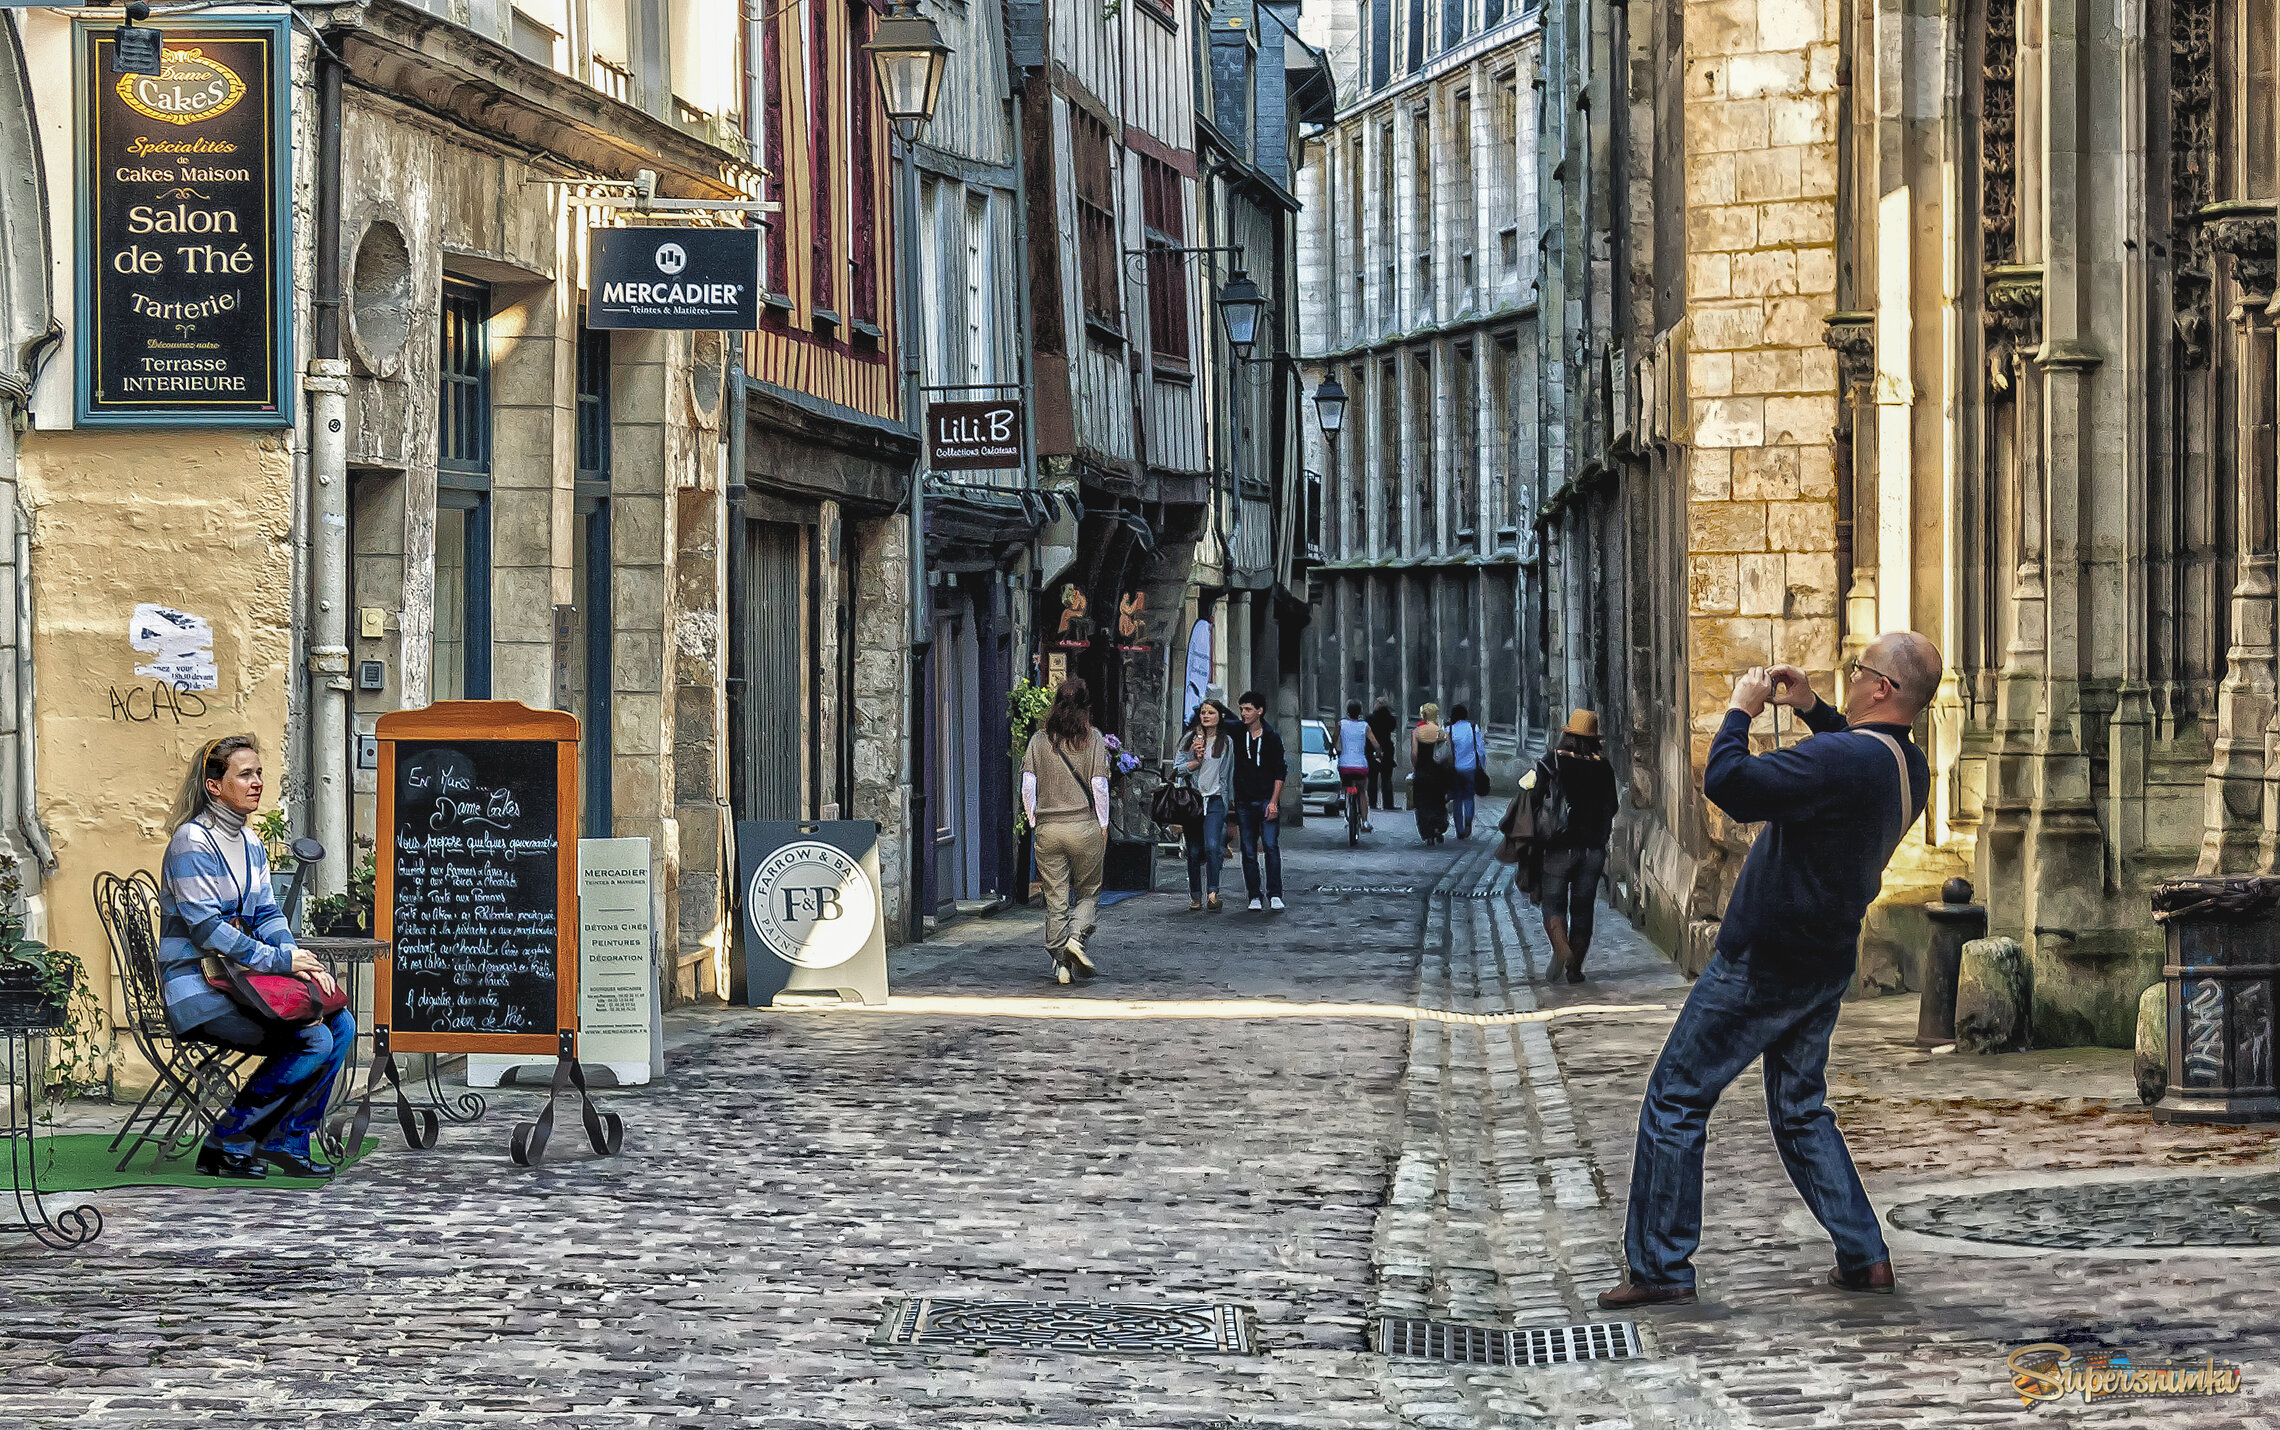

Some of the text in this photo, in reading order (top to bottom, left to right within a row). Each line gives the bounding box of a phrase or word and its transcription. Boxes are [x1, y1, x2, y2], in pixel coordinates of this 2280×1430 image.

[153, 65, 214, 81] Dame
[126, 136, 238, 158] Spécialités
[176, 156, 190, 165] de
[116, 166, 250, 182] Cakes Maison
[128, 203, 239, 234] Salon
[113, 242, 254, 275] de Thé
[131, 292, 235, 320] Tarterie
[630, 305, 710, 315] Teintes & Matières
[196, 341, 220, 349] notre
[141, 357, 227, 373] Terrasse
[122, 376, 247, 392] INTERIEURE
[935, 446, 979, 458] Collections
[109, 680, 207, 724] ACAB
[429, 796, 482, 831] Dame
[584, 869, 647, 877] MERCADIER
[758, 849, 812, 896] FARROW
[818, 851, 829, 863] &
[780, 886, 844, 922] F&B
[589, 954, 643, 962] DÉCORATION
